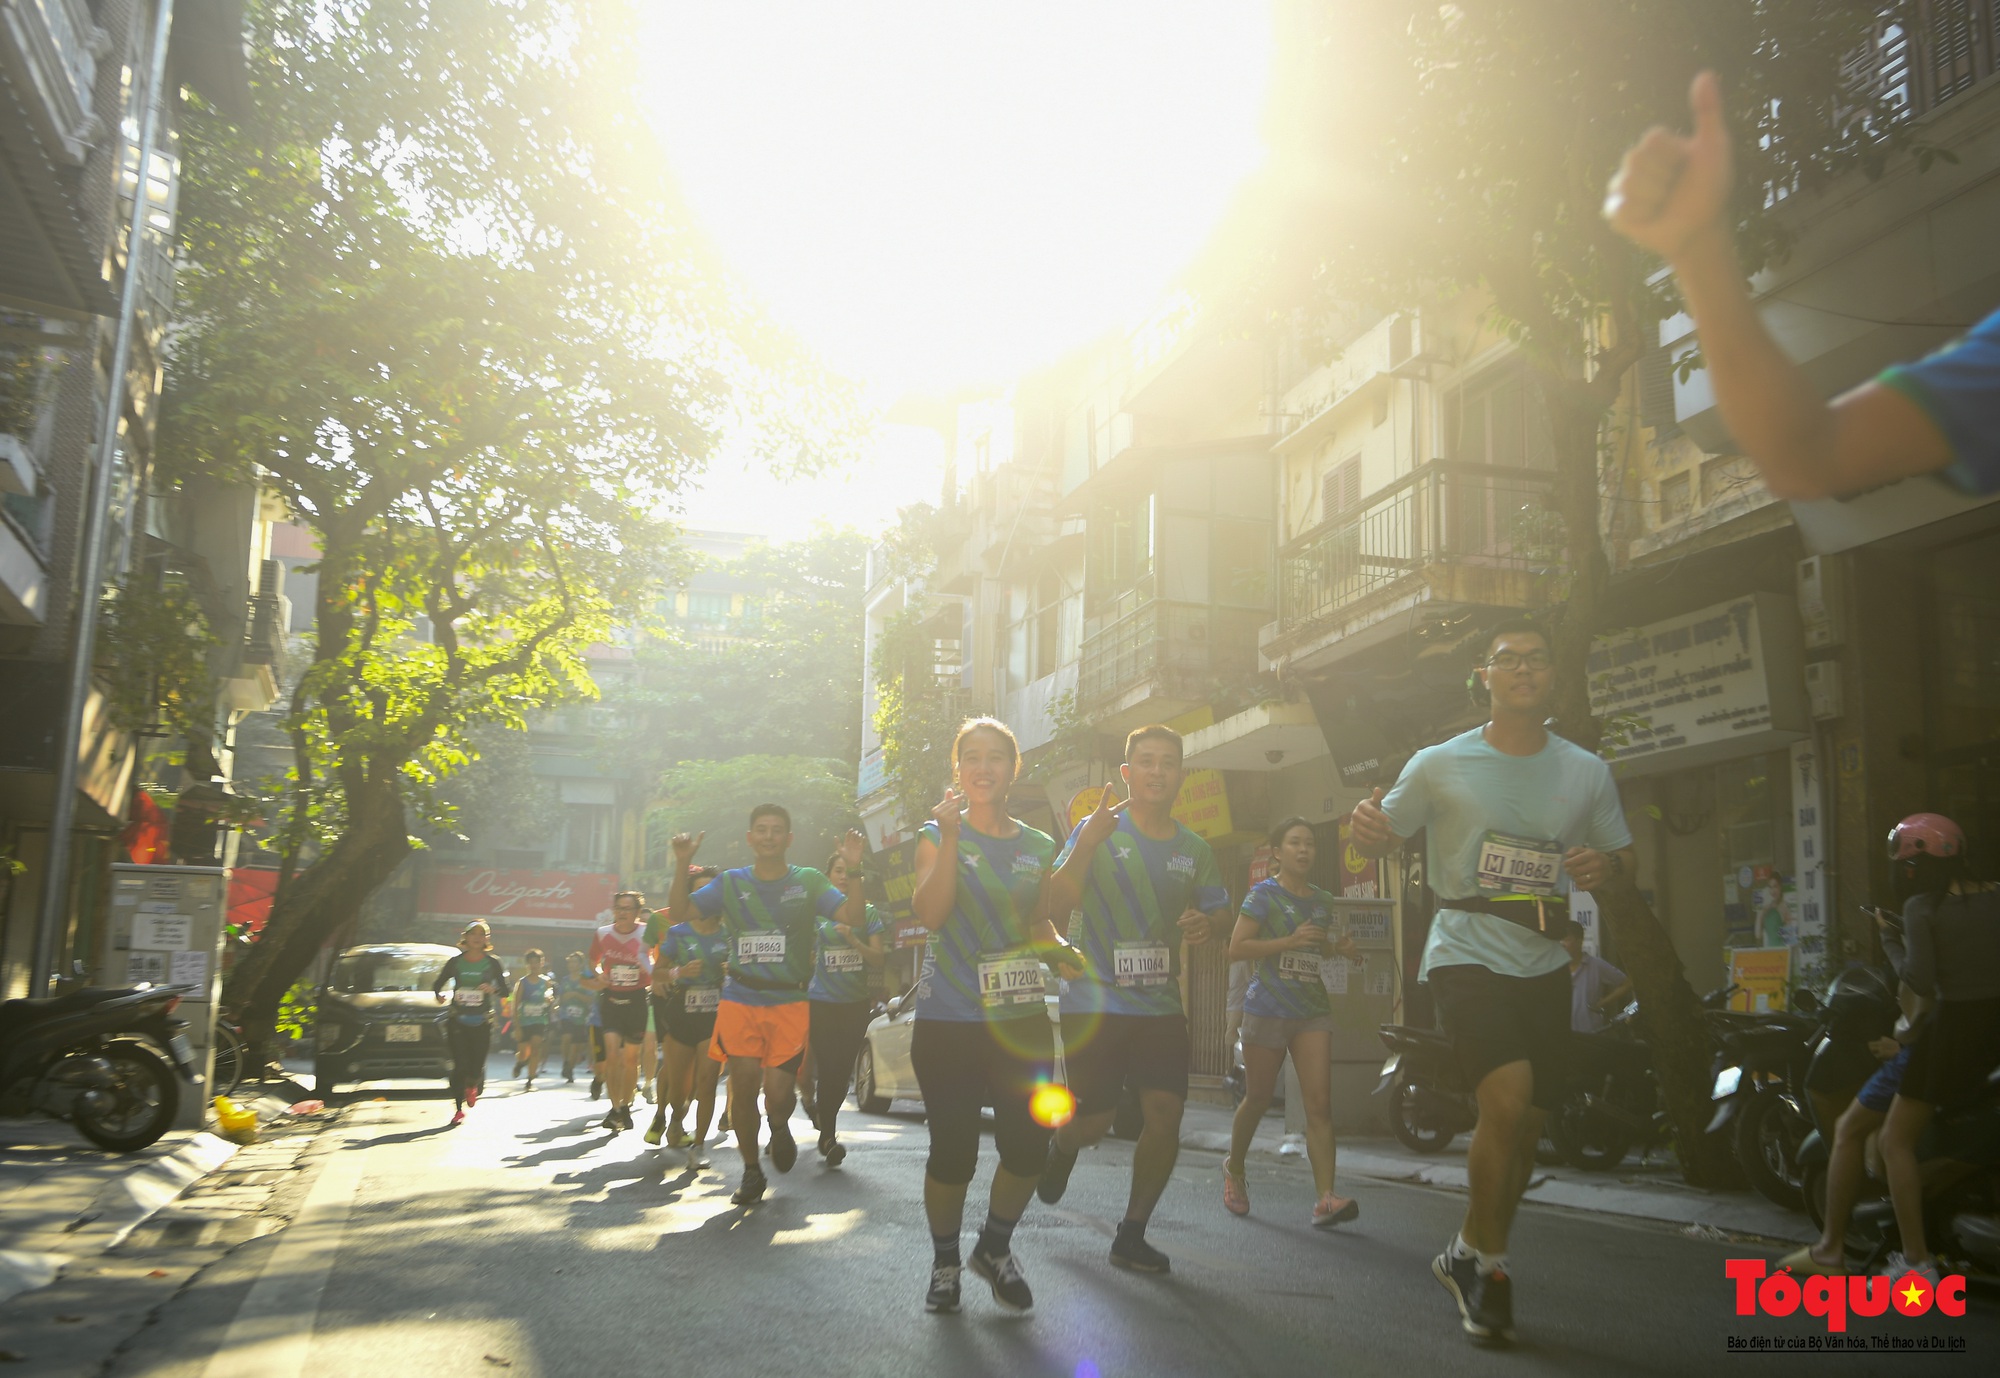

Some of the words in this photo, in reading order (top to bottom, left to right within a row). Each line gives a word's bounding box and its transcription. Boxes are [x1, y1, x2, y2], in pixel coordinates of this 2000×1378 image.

[1510, 859, 1552, 879] 10862
[465, 871, 574, 914] Origato
[755, 942, 781, 952] 18863
[1138, 957, 1163, 971] 11064
[1004, 970, 1039, 987] 17202
